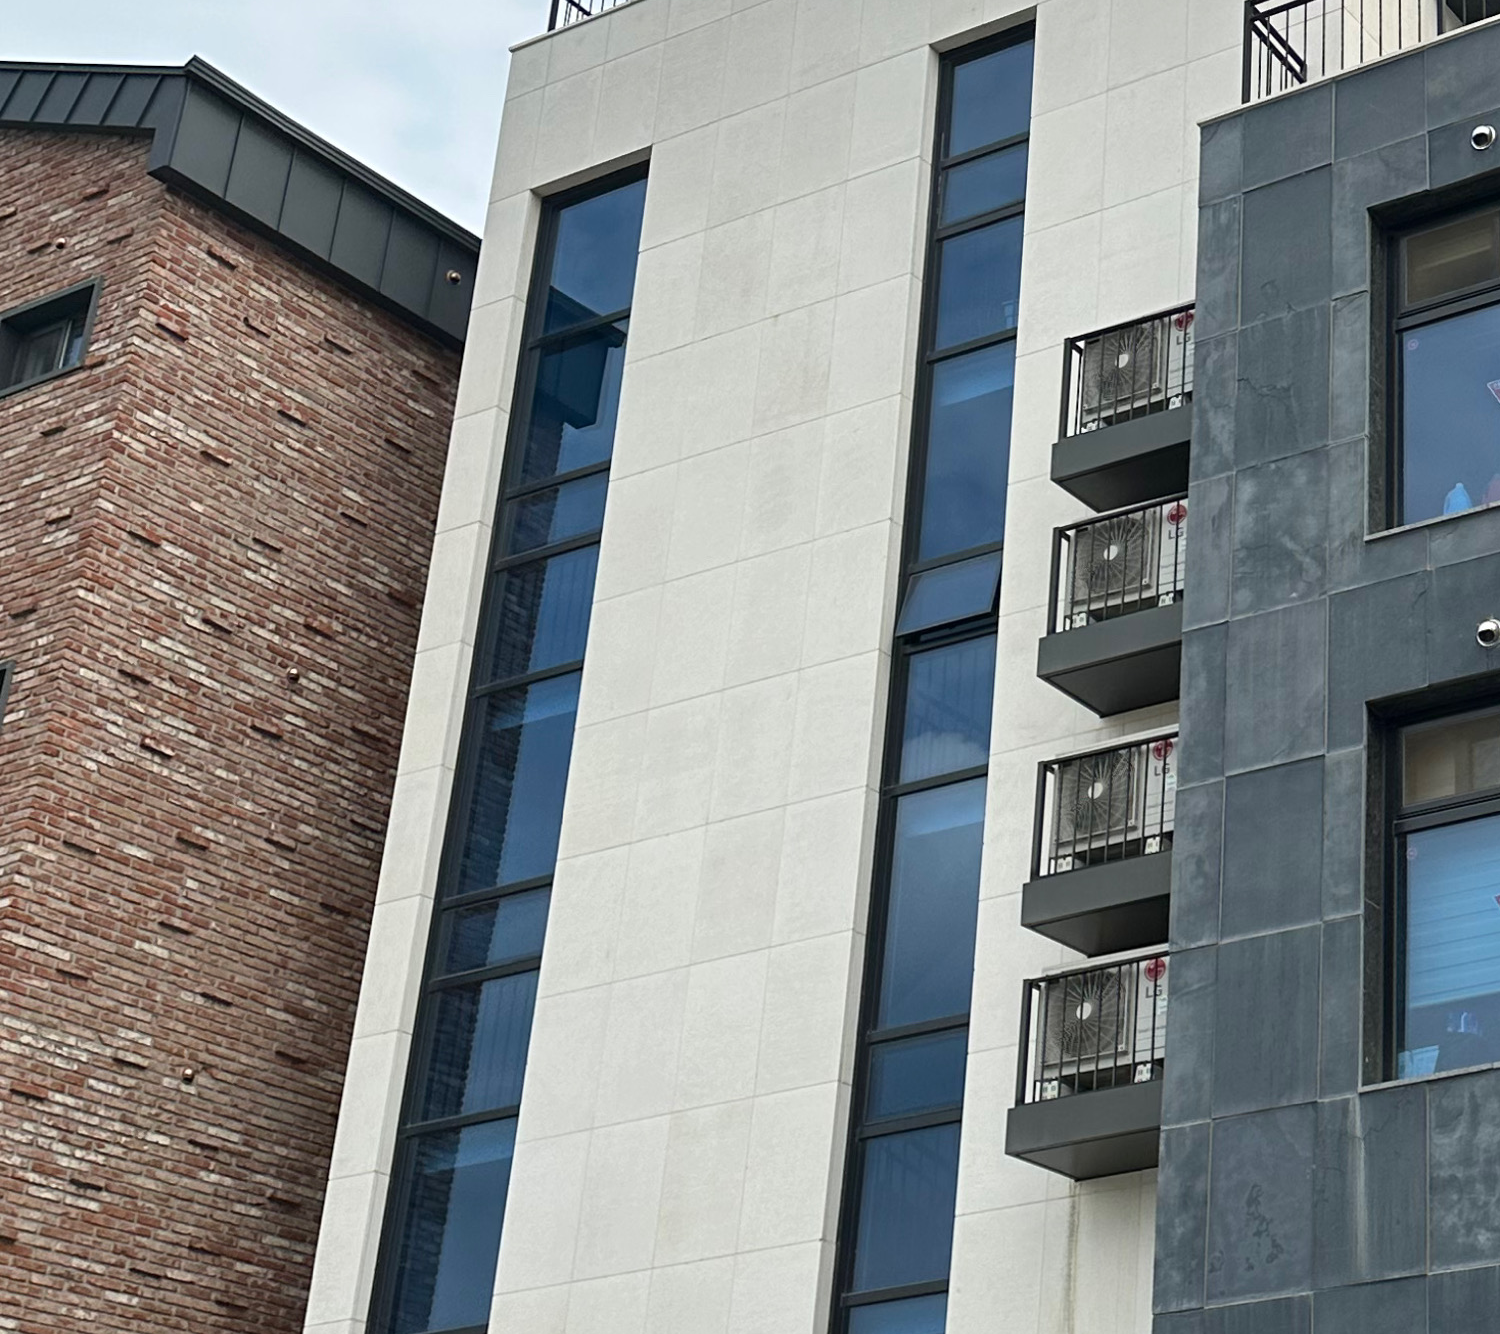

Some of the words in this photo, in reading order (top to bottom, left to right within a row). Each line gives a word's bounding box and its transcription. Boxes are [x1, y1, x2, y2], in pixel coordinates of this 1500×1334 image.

[1168, 527, 1184, 540] LG
[1154, 763, 1170, 776] LG
[1145, 984, 1163, 998] LG
